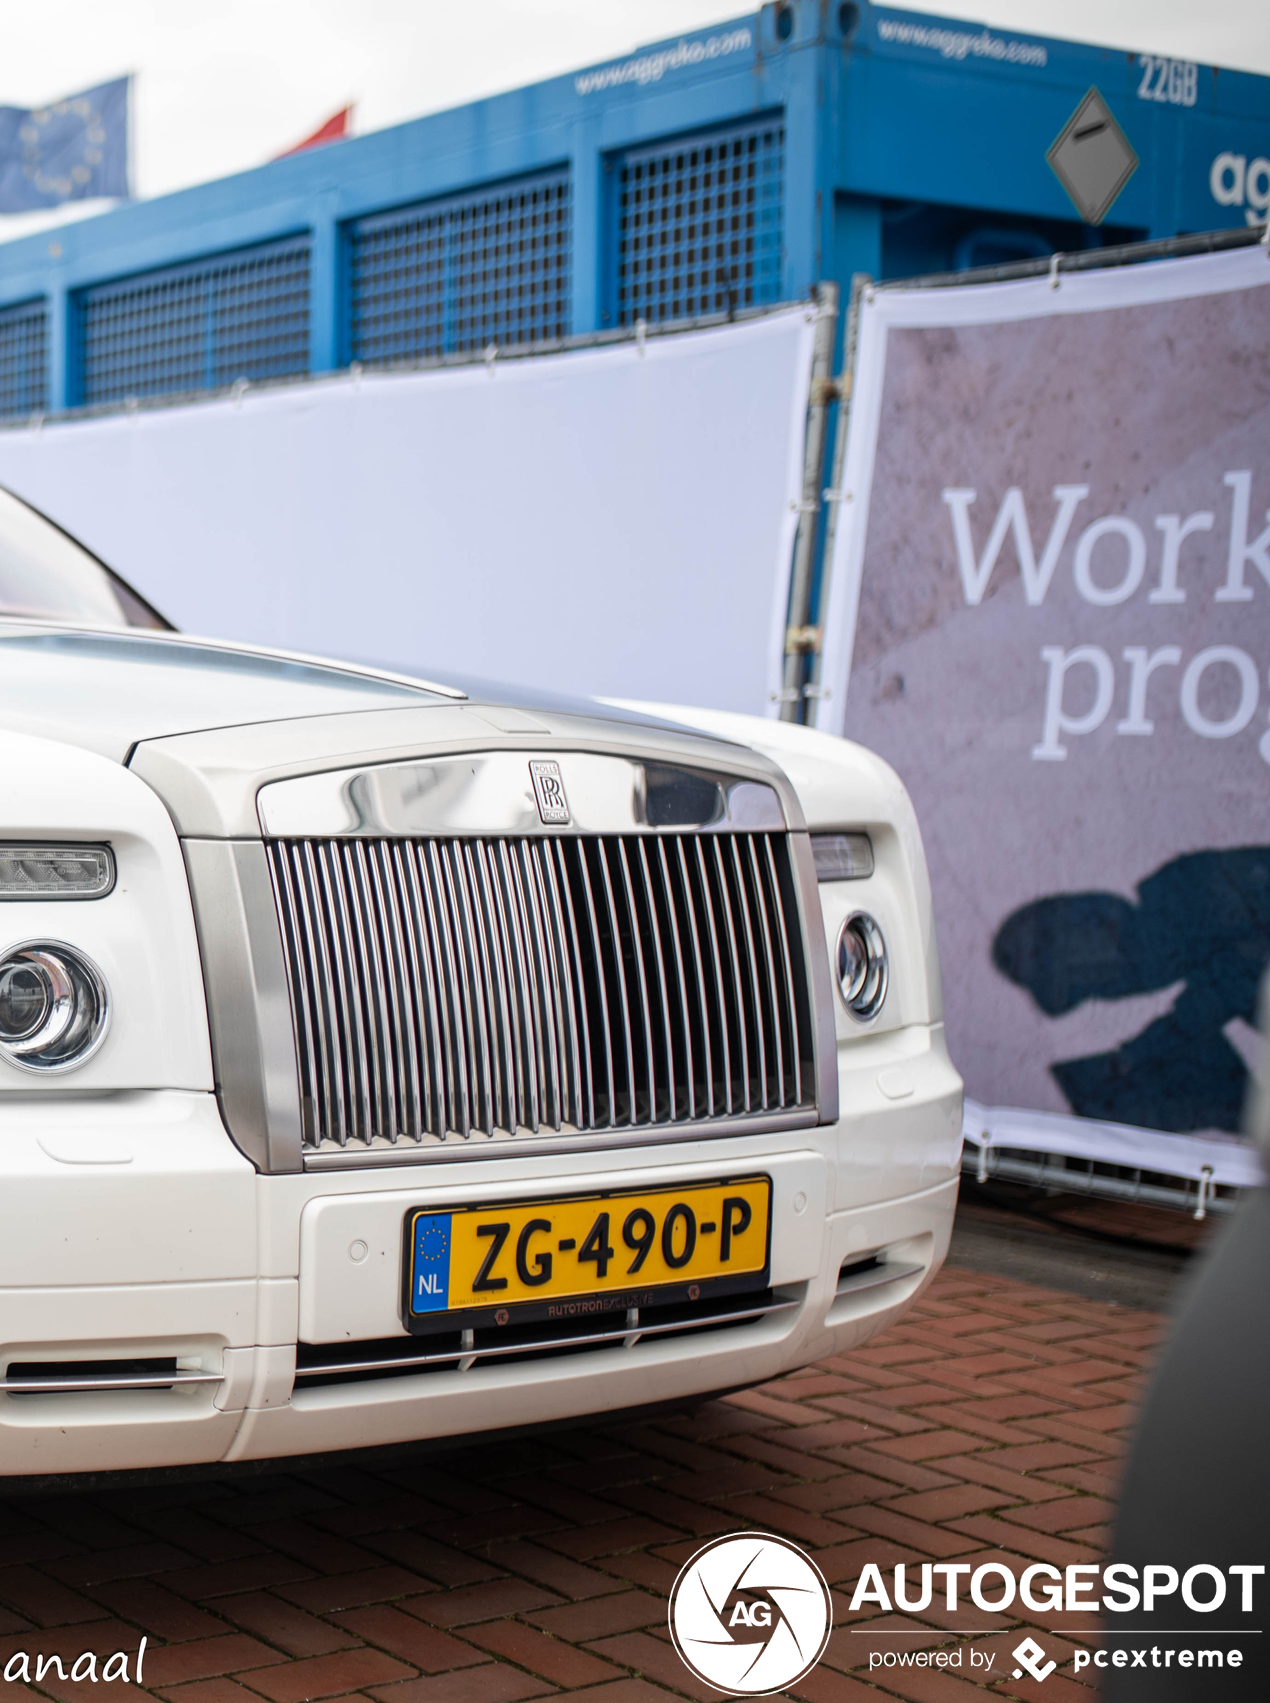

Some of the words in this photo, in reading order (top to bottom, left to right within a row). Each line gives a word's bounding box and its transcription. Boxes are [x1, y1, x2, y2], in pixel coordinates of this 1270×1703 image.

[1137, 54, 1198, 107] 22GB
[535, 765, 558, 774] ROLLS
[546, 812, 568, 820] ROYCE
[472, 1197, 752, 1292] ZG-490-P
[418, 1273, 444, 1296] NL
